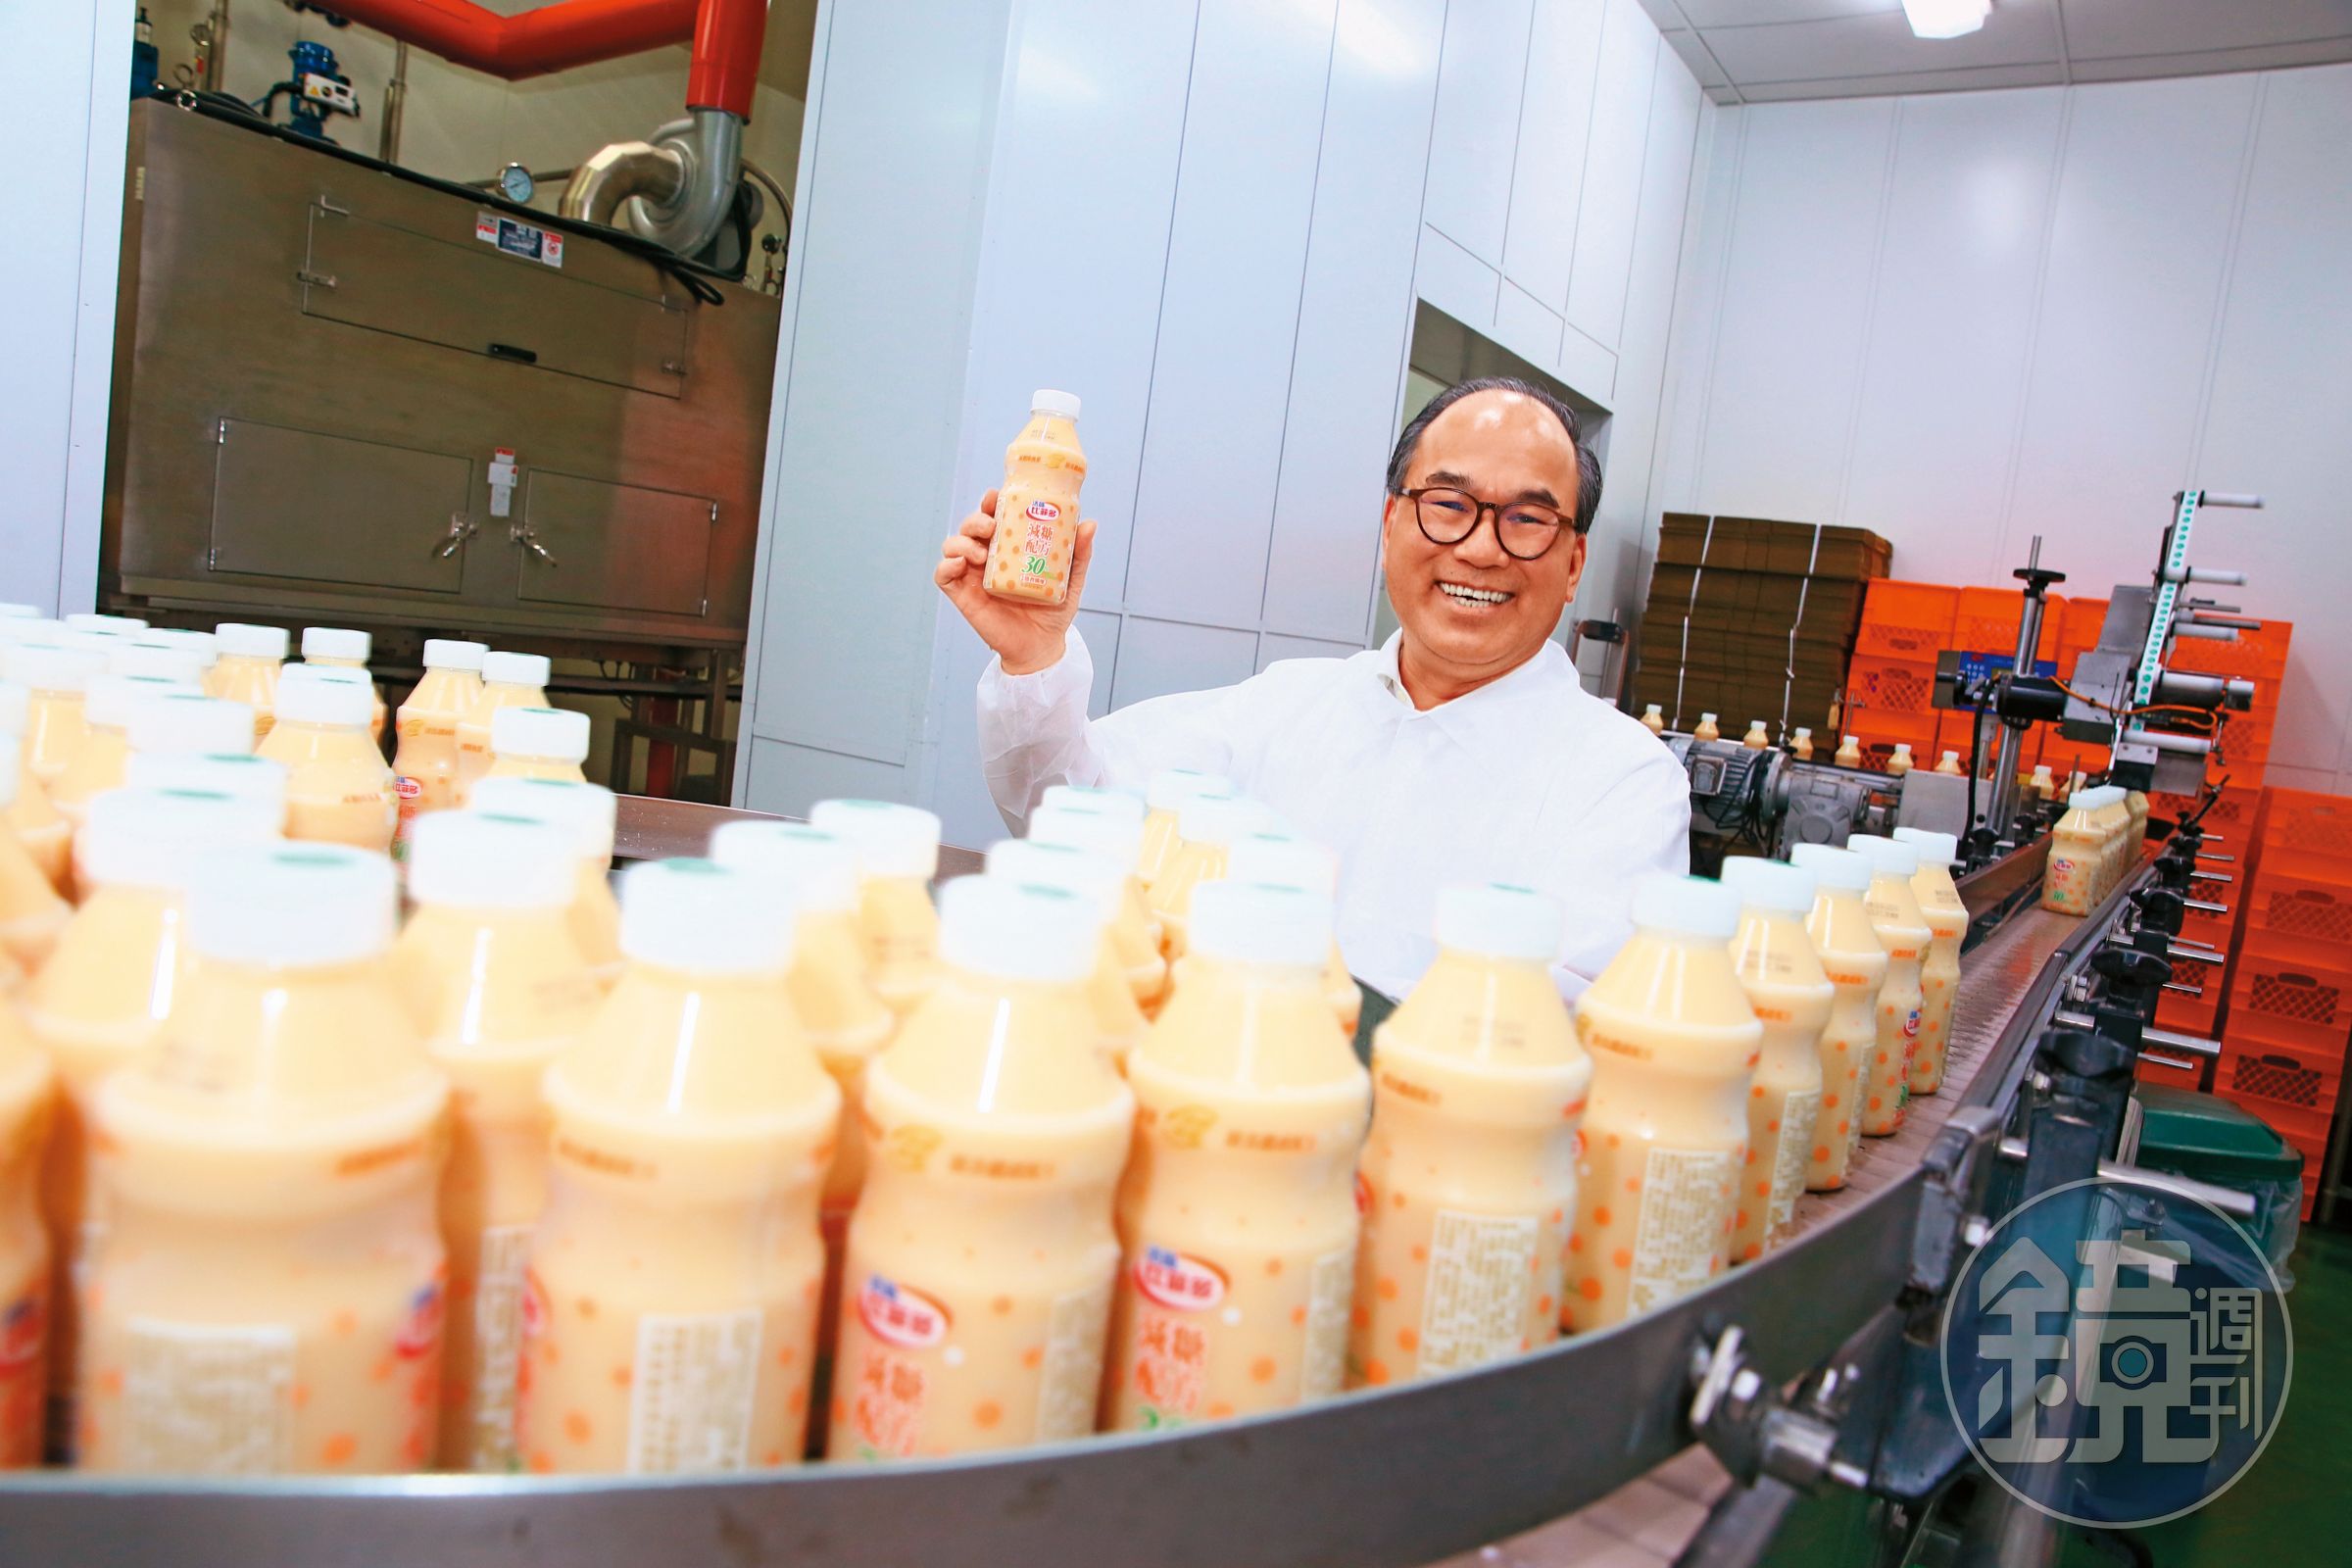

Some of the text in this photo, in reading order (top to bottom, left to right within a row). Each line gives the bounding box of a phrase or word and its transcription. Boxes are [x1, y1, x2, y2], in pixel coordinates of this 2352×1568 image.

[1031, 507, 1056, 517] 比菲多
[1027, 523, 1054, 541] 減糖
[1025, 540, 1052, 556] 配方
